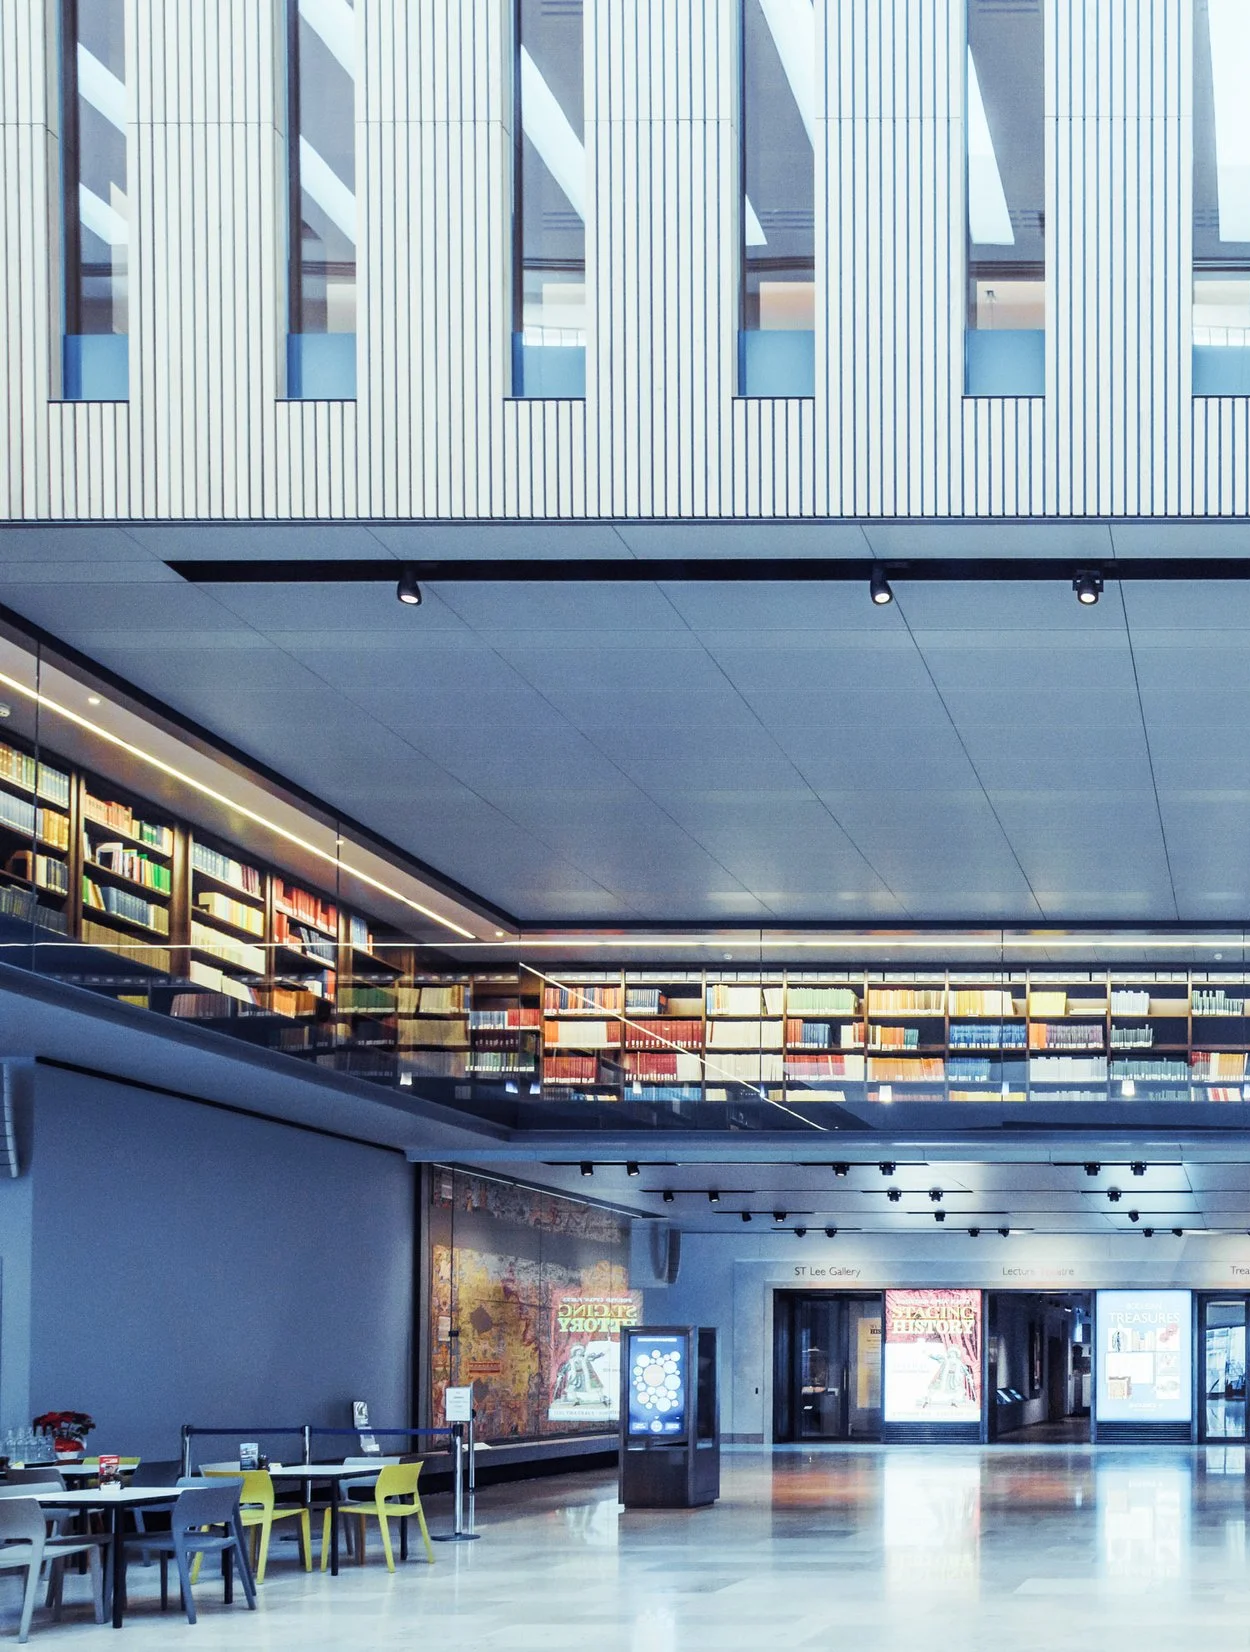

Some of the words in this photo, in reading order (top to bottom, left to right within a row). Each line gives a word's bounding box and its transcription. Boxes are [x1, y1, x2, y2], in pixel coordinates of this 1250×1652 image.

[794, 1266, 807, 1276] ST
[809, 1266, 827, 1276] Lee
[828, 1266, 861, 1278] Gallery
[891, 1306, 975, 1319] STAGING
[1107, 1312, 1181, 1324] TREASURES
[891, 1319, 976, 1335] HISTORY
